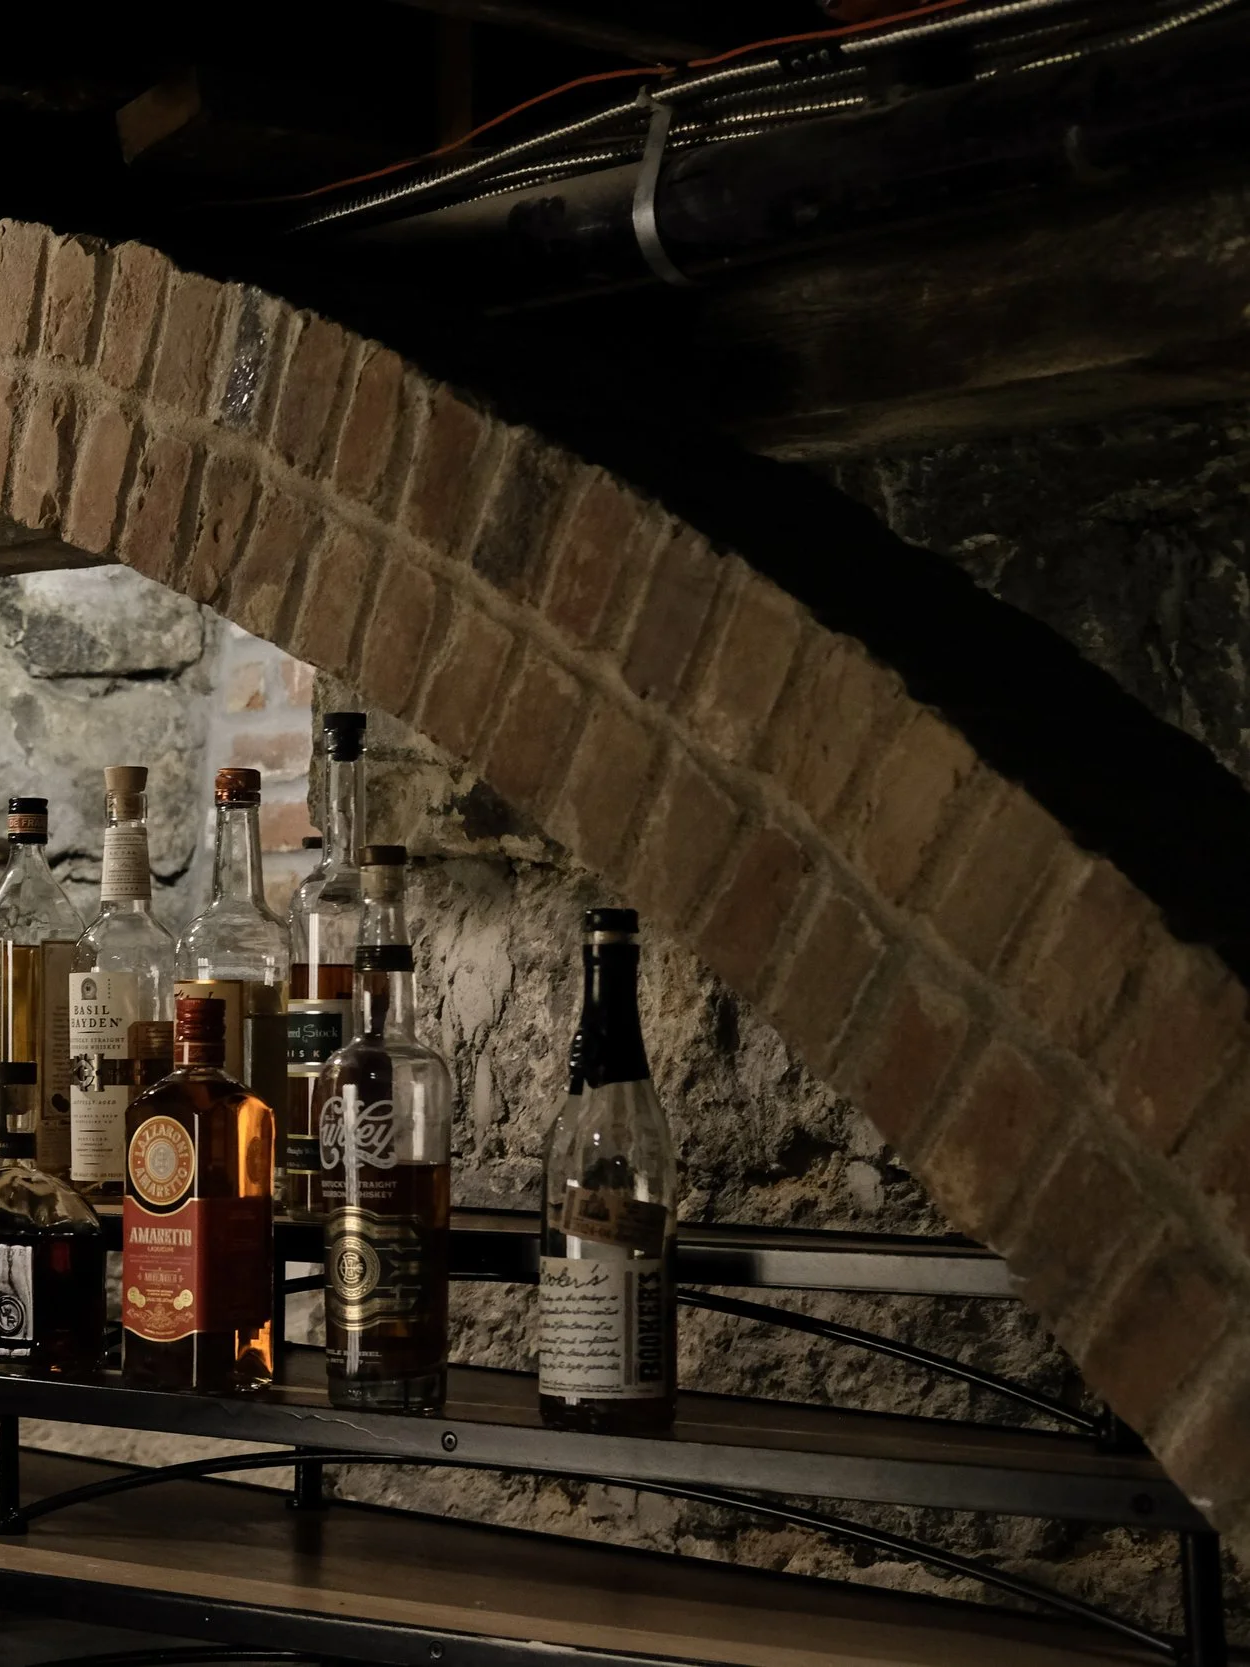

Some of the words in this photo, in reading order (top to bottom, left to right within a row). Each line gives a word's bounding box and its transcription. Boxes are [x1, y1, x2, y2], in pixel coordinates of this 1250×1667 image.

[73, 1004, 110, 1015] BASIL
[301, 1023, 338, 1043] Stock
[133, 1123, 190, 1158] LAZZARONI
[134, 1166, 188, 1198] AMARETTO
[129, 1226, 192, 1247] AMARETTO
